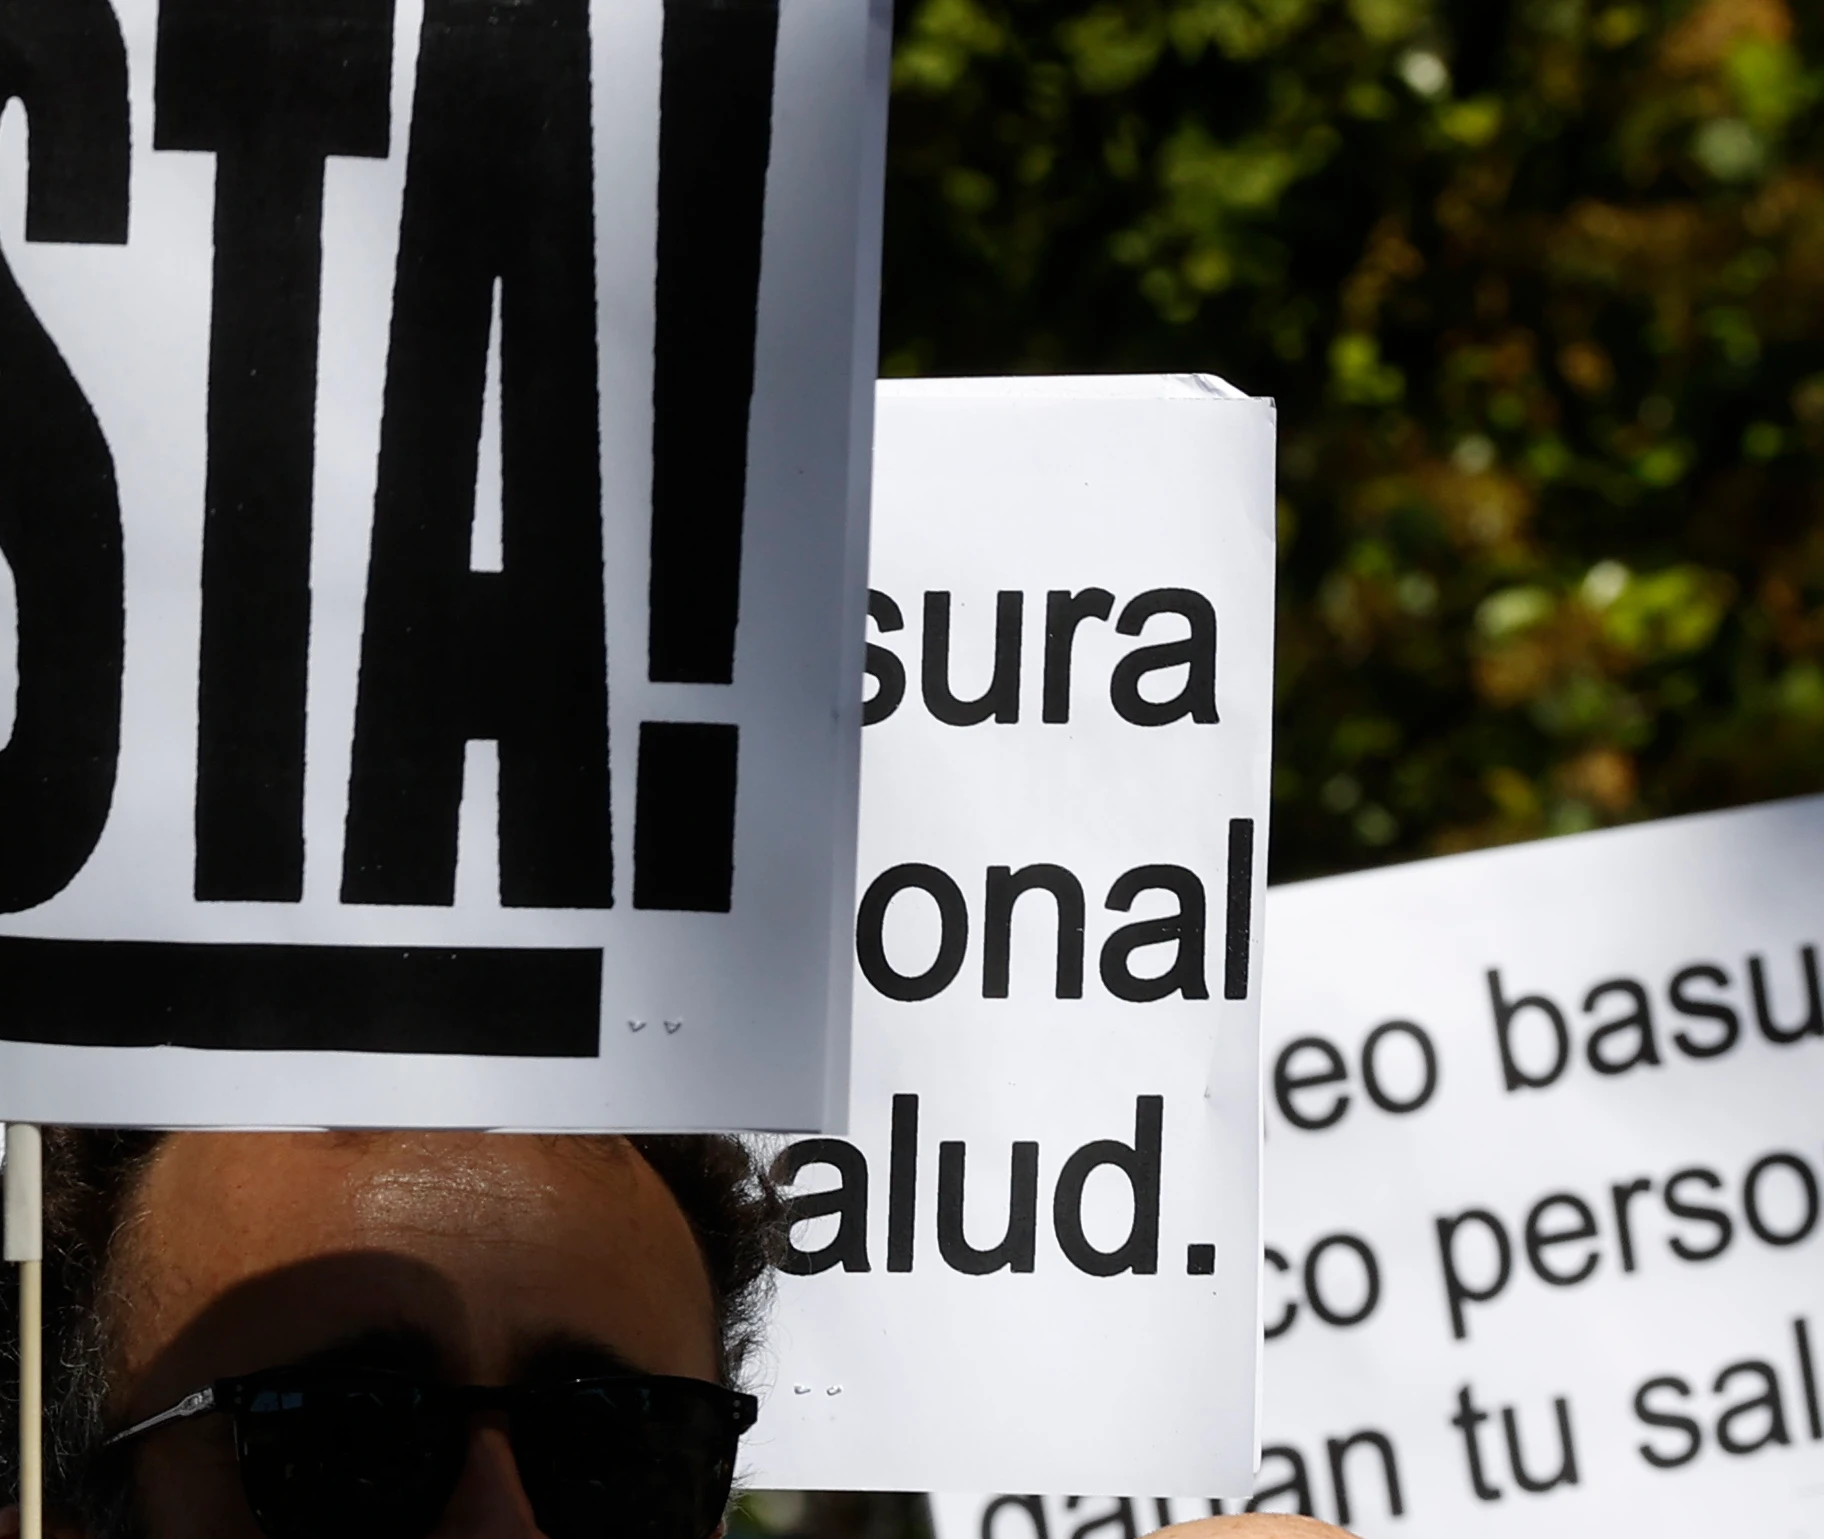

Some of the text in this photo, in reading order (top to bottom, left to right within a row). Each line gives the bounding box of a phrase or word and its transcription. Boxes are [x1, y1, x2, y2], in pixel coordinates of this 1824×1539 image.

[856, 817, 1254, 1002] onal
[1486, 945, 1824, 1092] basu
[770, 1093, 1216, 1277] alud.
[1435, 1150, 1822, 1341] perso
[1450, 1382, 1580, 1503] tu
[1632, 1317, 1824, 1470] sal
